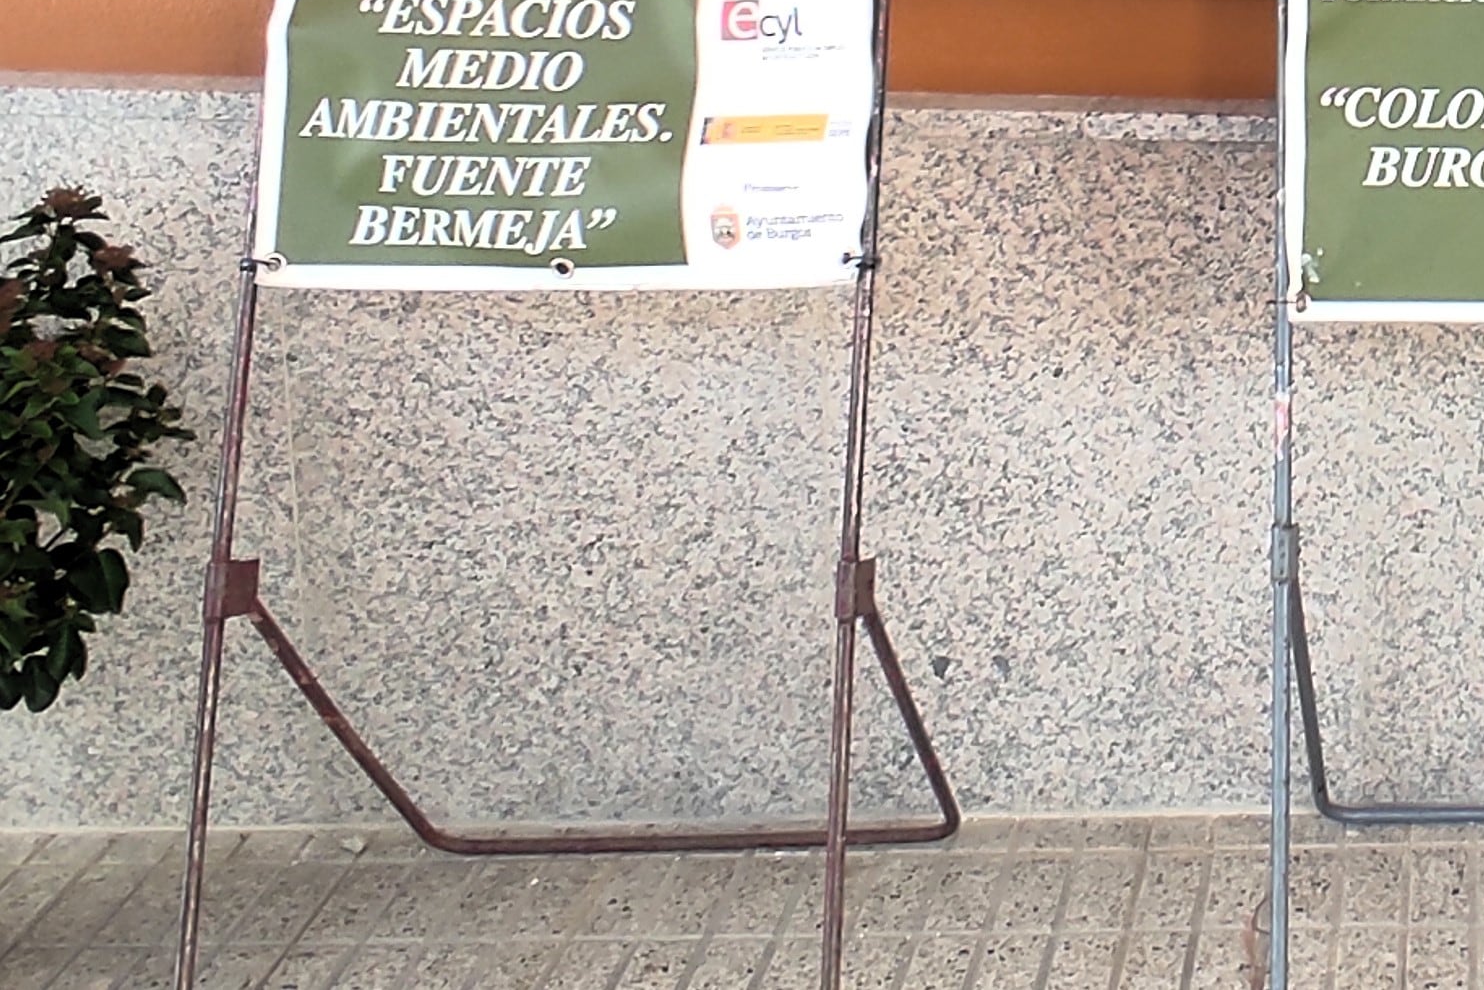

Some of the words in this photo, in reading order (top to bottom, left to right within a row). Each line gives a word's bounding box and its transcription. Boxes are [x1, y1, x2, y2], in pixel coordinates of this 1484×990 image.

[395, 48, 584, 92] MEDIO
[298, 97, 673, 144] AMBIENTALES.
[378, 154, 592, 197] FUENTE
[348, 205, 617, 255] BERMEJA”
